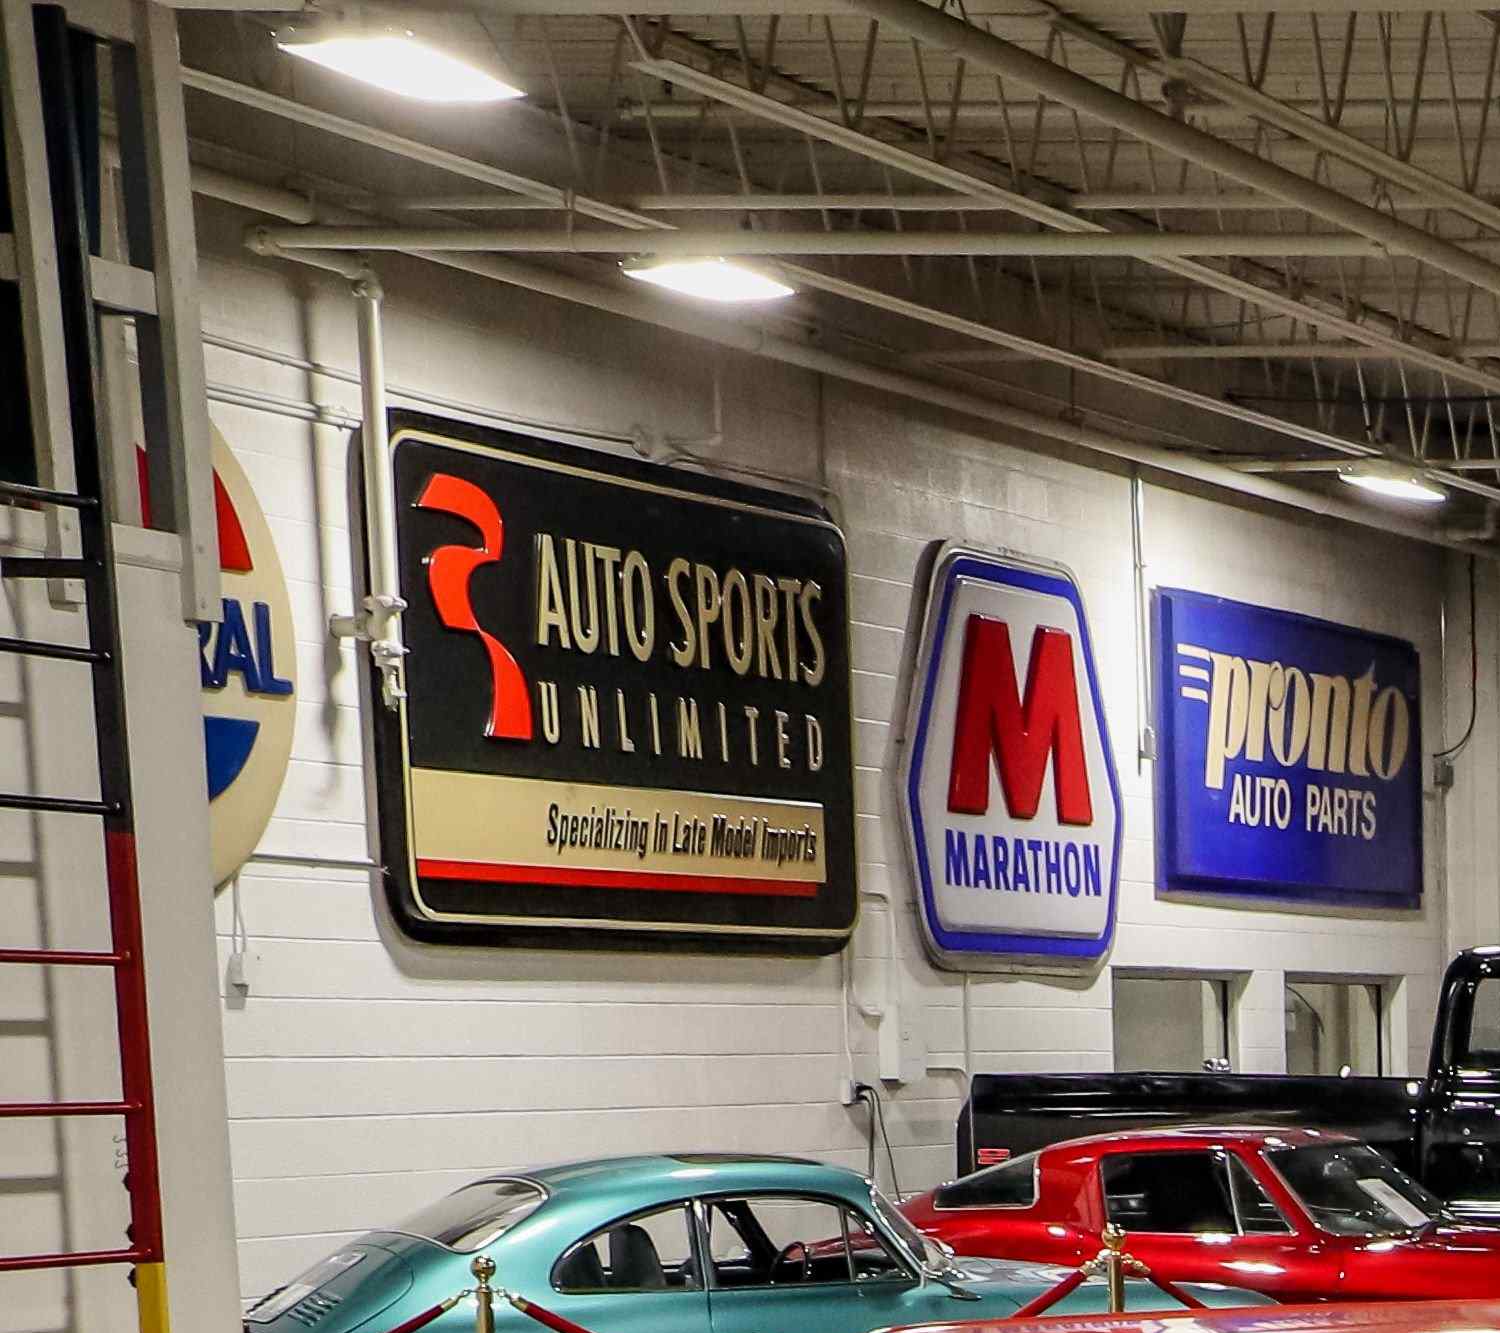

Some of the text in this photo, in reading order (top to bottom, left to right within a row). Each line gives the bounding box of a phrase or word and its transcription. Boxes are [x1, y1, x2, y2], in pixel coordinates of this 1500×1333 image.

[534, 532, 826, 688] AUTO SPORTS
[537, 680, 825, 772] UNLIMITED
[946, 612, 1094, 826] M
[1202, 650, 1410, 790] pronto
[546, 801, 818, 865] Specializing In Late Model Imports
[1228, 772, 1378, 841] AUTO PARTS
[944, 828, 1101, 898] MARATHON
